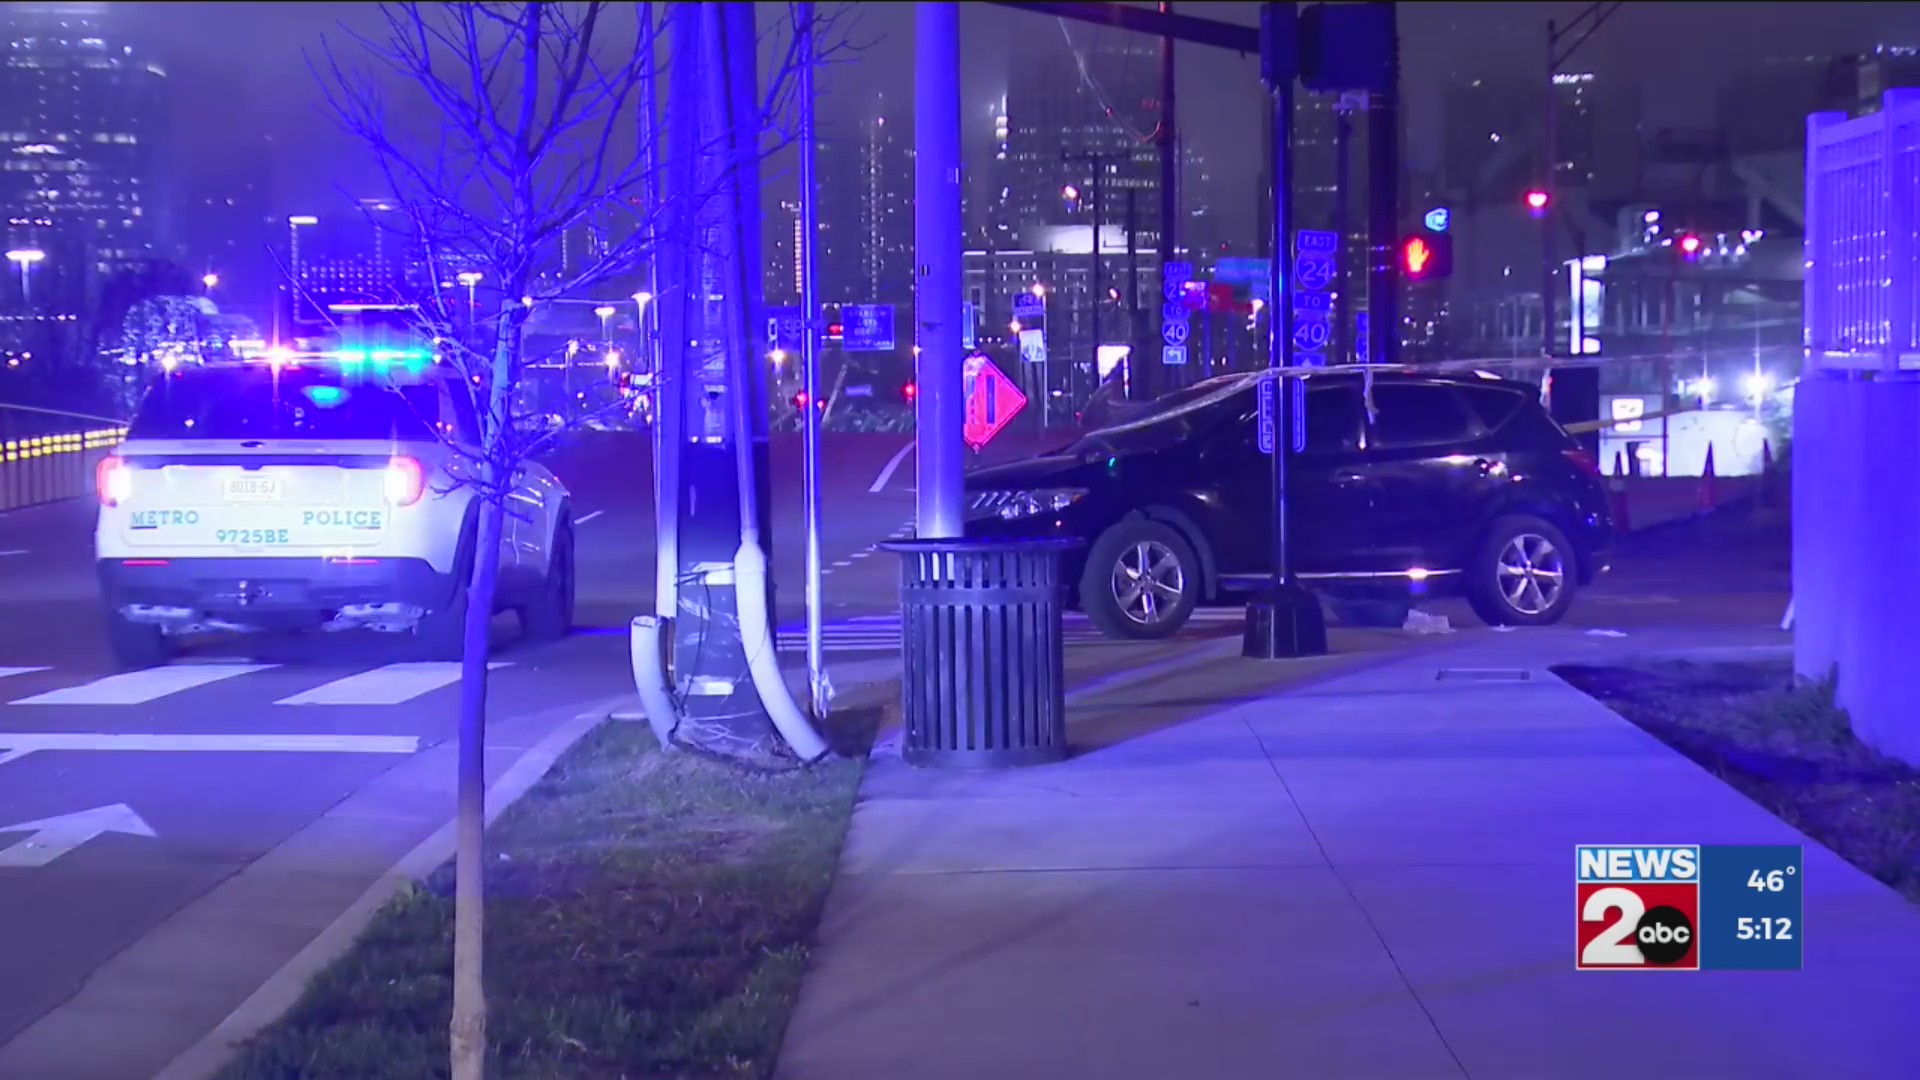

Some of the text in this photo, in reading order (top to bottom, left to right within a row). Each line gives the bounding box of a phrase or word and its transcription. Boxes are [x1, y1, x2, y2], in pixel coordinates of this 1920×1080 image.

[1304, 235, 1331, 248] EAST
[1303, 260, 1330, 282] 24
[1303, 295, 1321, 308] TO
[1165, 325, 1186, 340] 40
[1295, 323, 1326, 343] 40
[130, 510, 382, 526] METRO POLICE
[215, 529, 290, 544] 9725BE
